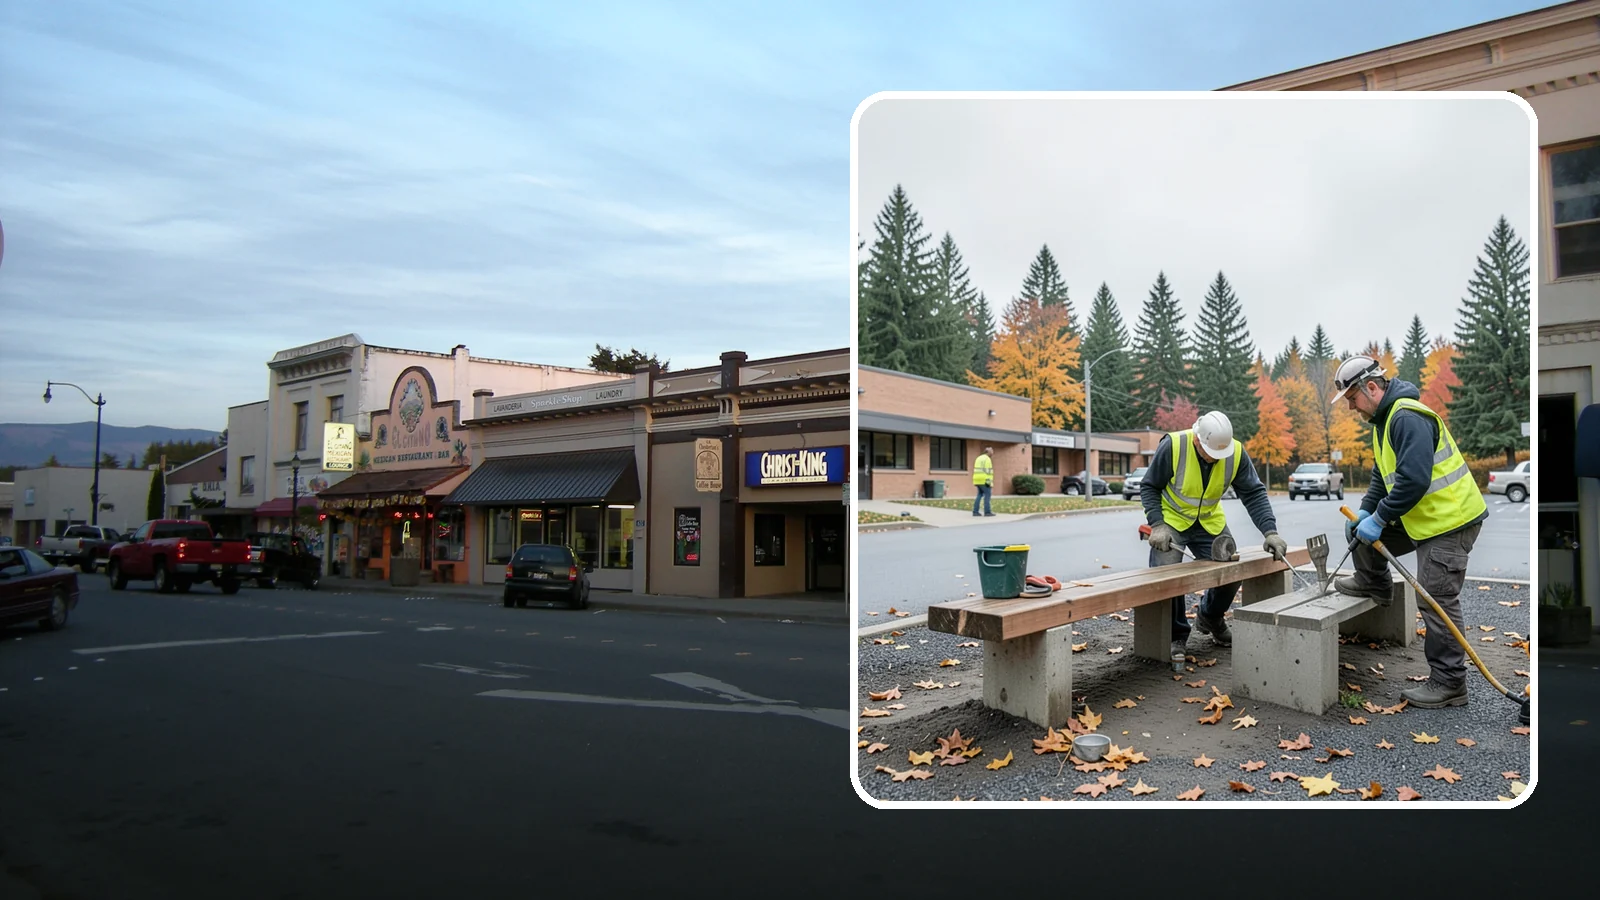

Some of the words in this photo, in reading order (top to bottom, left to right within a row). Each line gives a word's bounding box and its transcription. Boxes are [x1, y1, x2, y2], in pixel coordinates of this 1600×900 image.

[596, 389, 623, 400] LAUNDRY
[493, 402, 522, 412] LAVANDERIA
[531, 398, 560, 409] Sparkle
[562, 394, 582, 405] Shop
[373, 454, 396, 464] MEXICAN
[397, 451, 433, 462] RESTAURANT
[437, 450, 450, 459] BAR
[761, 452, 797, 477] CHRIST
[799, 450, 828, 476] KING
[697, 481, 709, 489] Coffee
[710, 481, 721, 489] House
